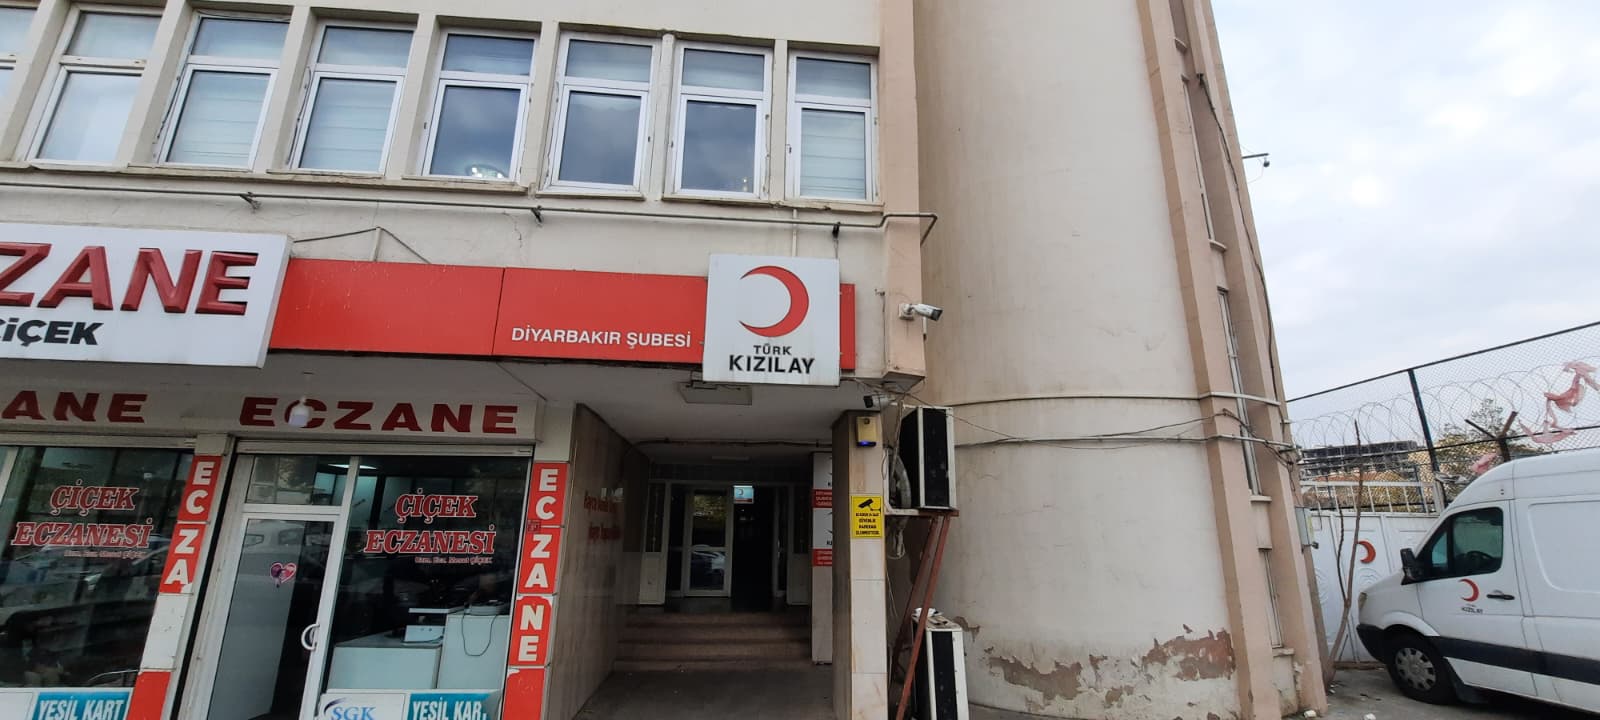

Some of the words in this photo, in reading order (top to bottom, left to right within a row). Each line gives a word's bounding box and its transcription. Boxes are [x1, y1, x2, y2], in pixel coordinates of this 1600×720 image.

[511, 324, 621, 346] DİYARBAKIR
[626, 330, 692, 350] ŞUBESİ
[753, 343, 792, 356] TÜRK
[728, 354, 816, 375] KIZILAY
[2, 390, 148, 423] ANE
[240, 396, 517, 434] ECZANE
[51, 479, 139, 516] ÇİÇEK
[395, 488, 478, 524] ÇİÇEK
[11, 517, 153, 548] ECZANESİ
[364, 524, 496, 554] ECZANESİ
